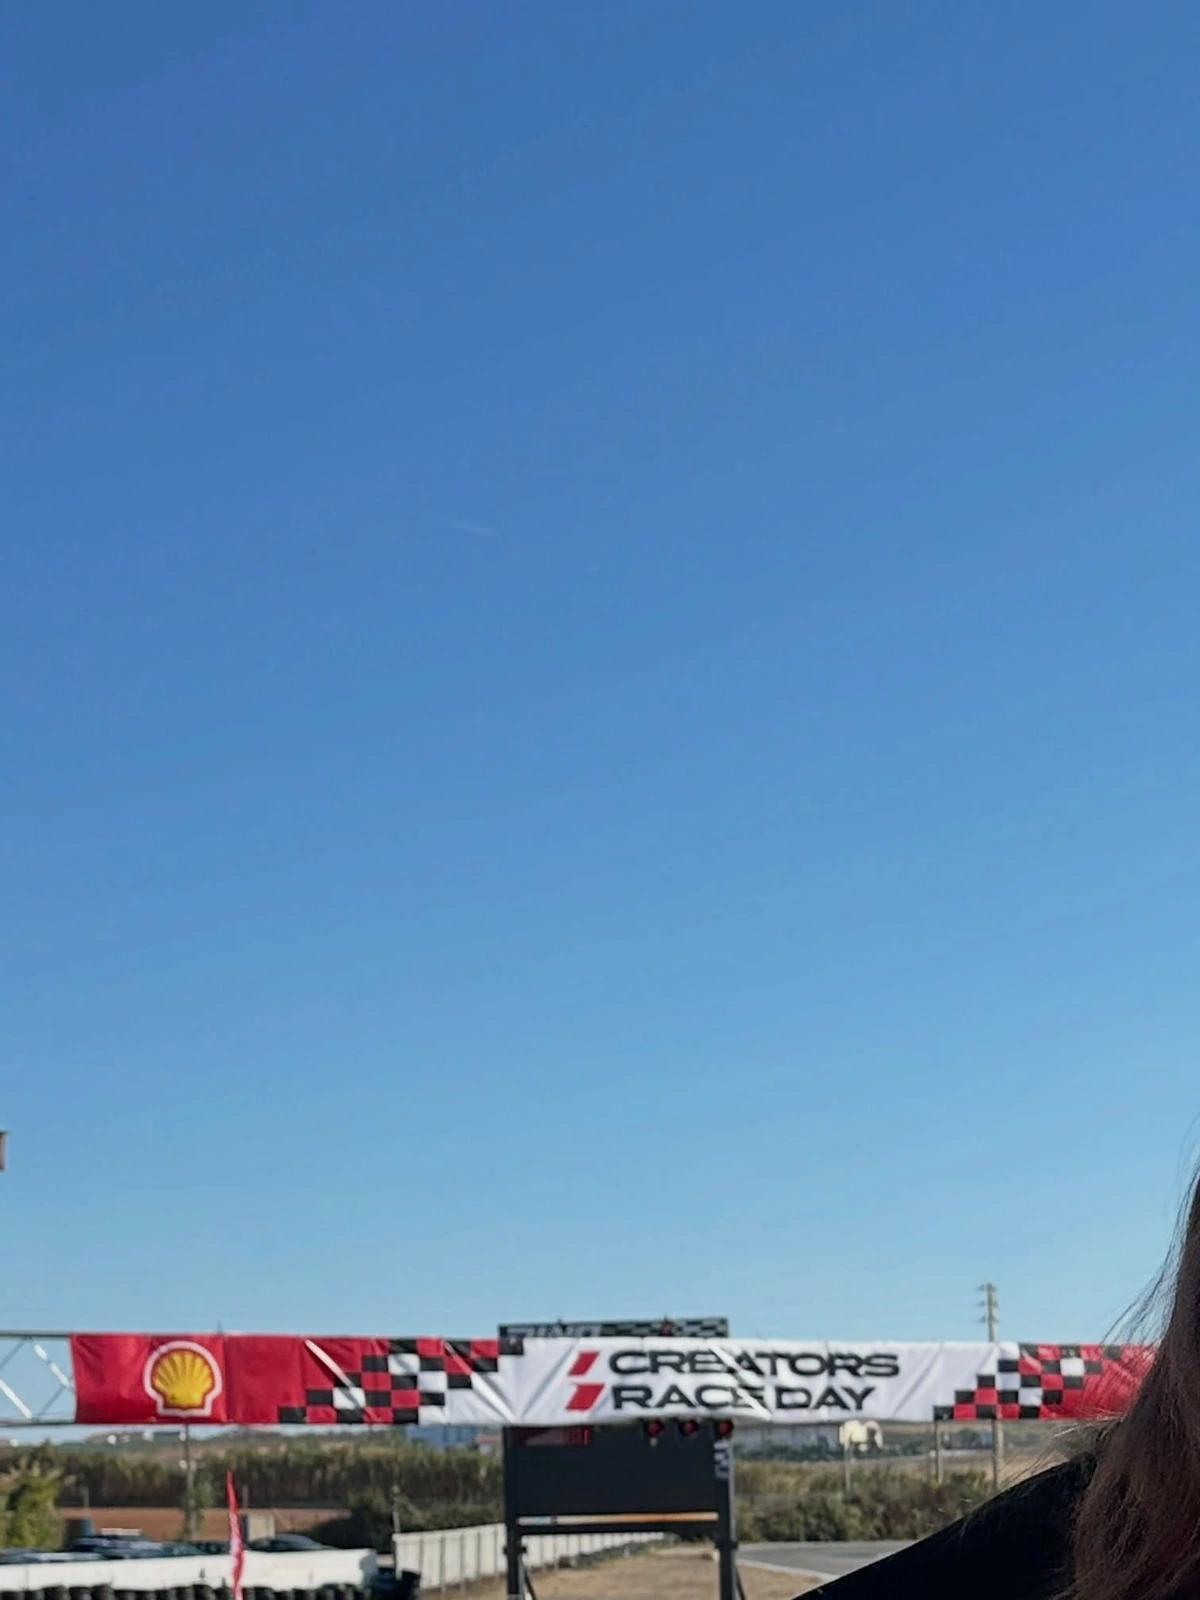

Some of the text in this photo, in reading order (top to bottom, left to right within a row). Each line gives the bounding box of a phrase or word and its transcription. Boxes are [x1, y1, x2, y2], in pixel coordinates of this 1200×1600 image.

[609, 1349, 899, 1378] CREATORS
[612, 1384, 877, 1411] RACE DAY
